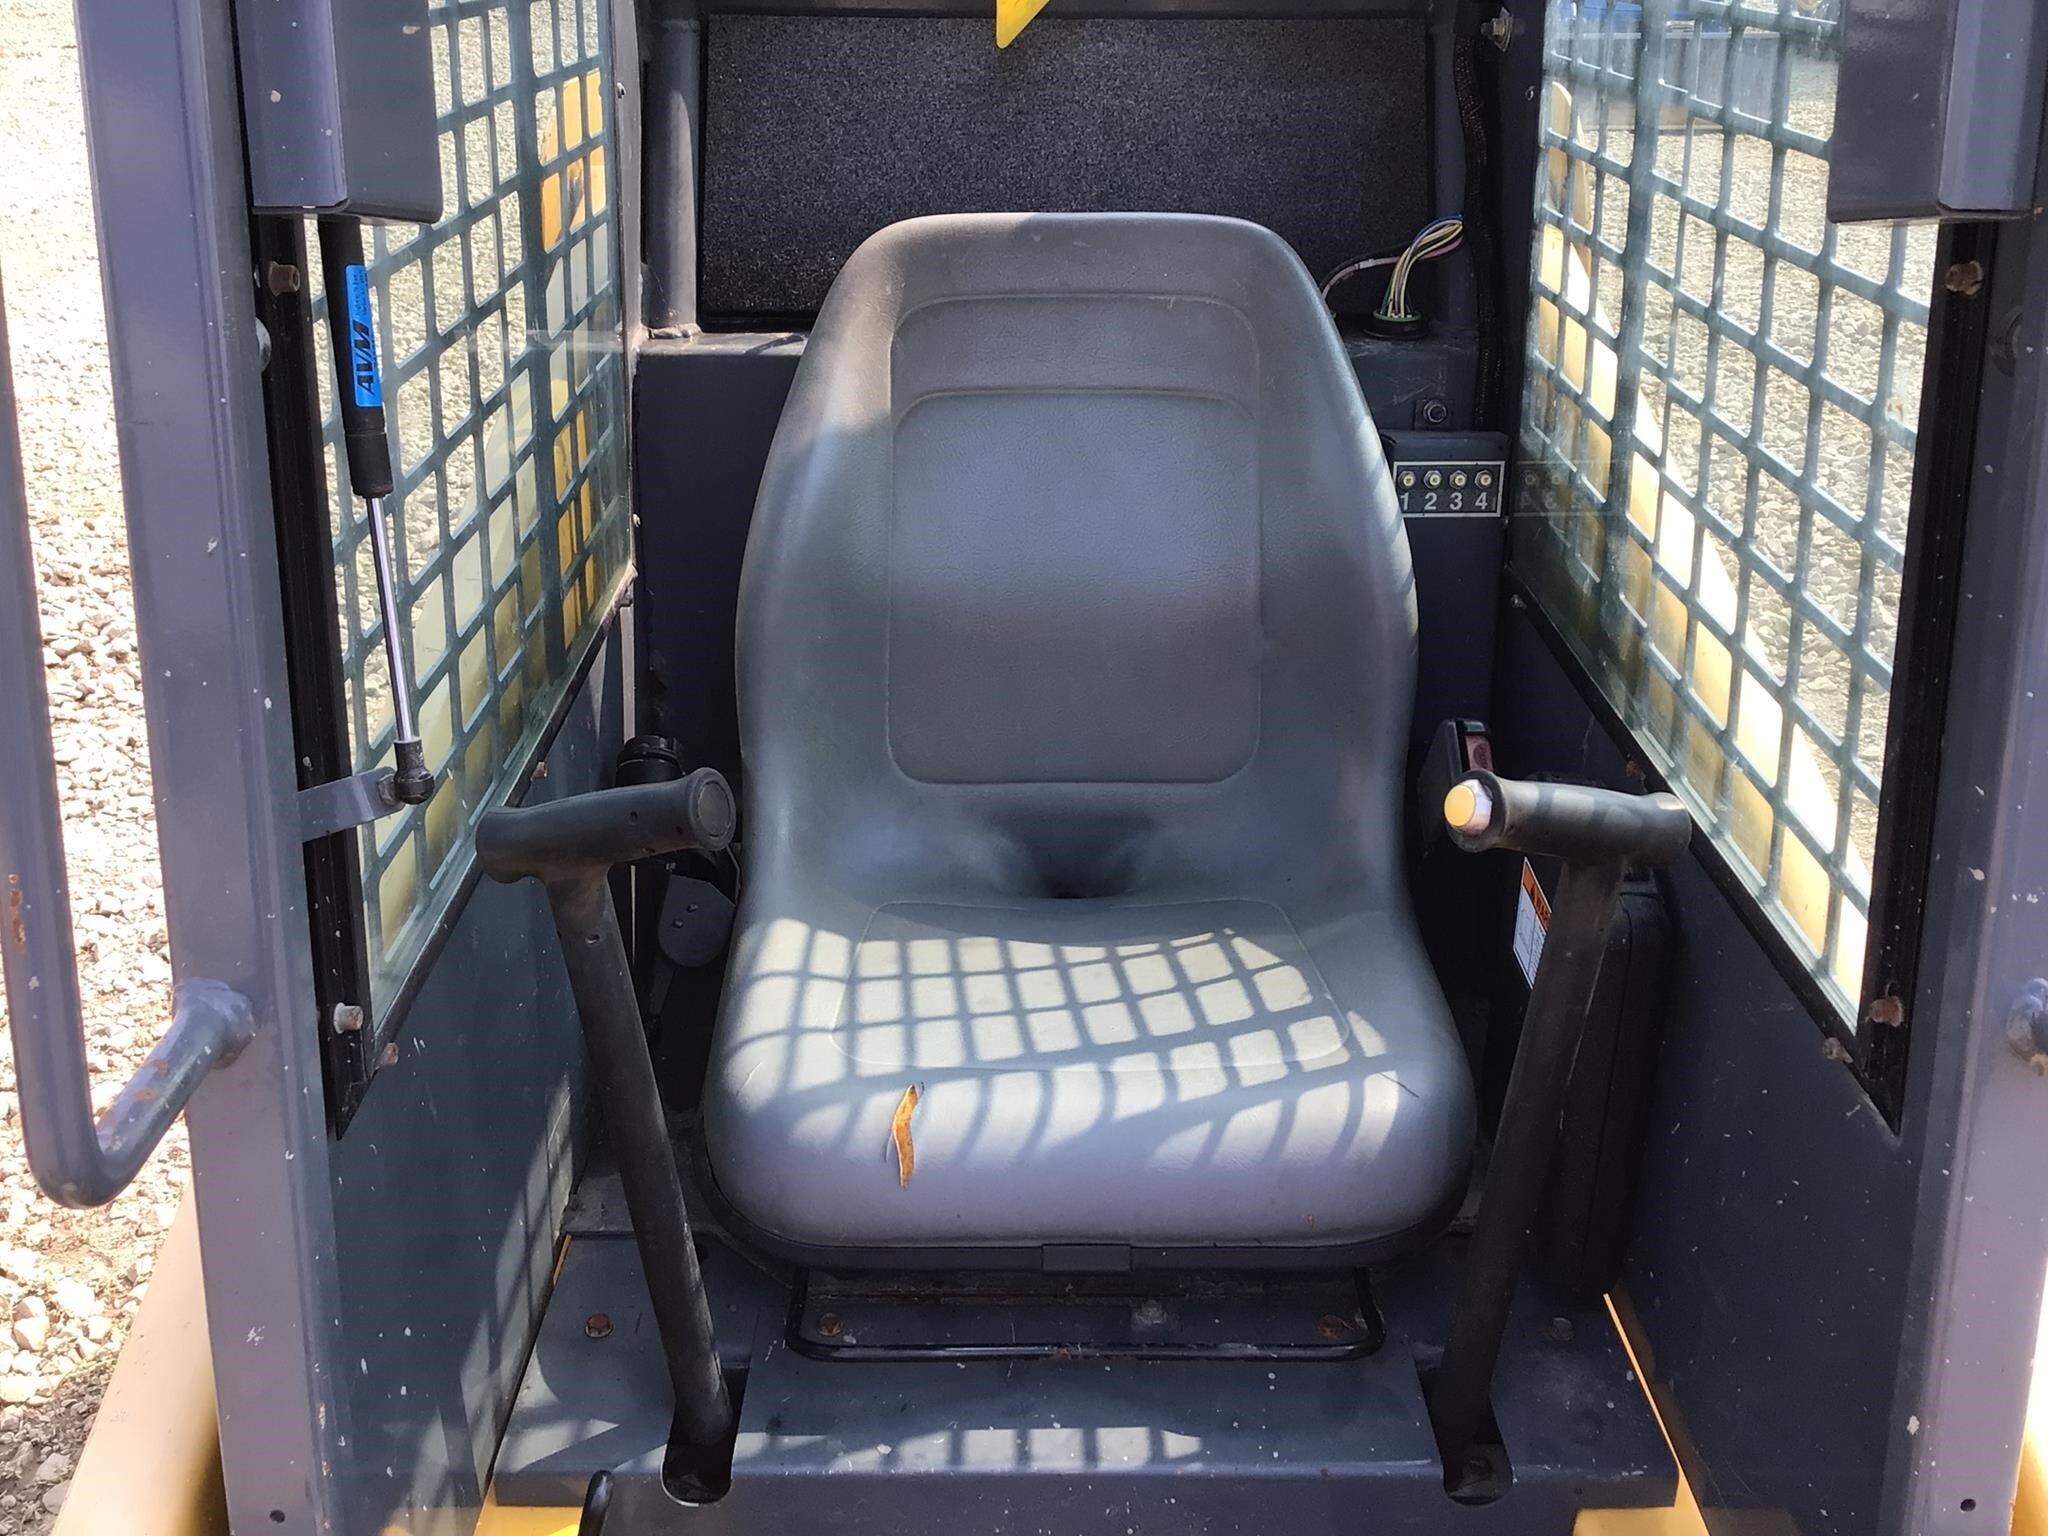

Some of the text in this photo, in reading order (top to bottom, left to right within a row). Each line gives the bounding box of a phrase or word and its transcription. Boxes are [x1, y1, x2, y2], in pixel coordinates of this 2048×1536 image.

[352, 319, 375, 395] AVM
[1400, 492, 1488, 511] 1 2 3 4
